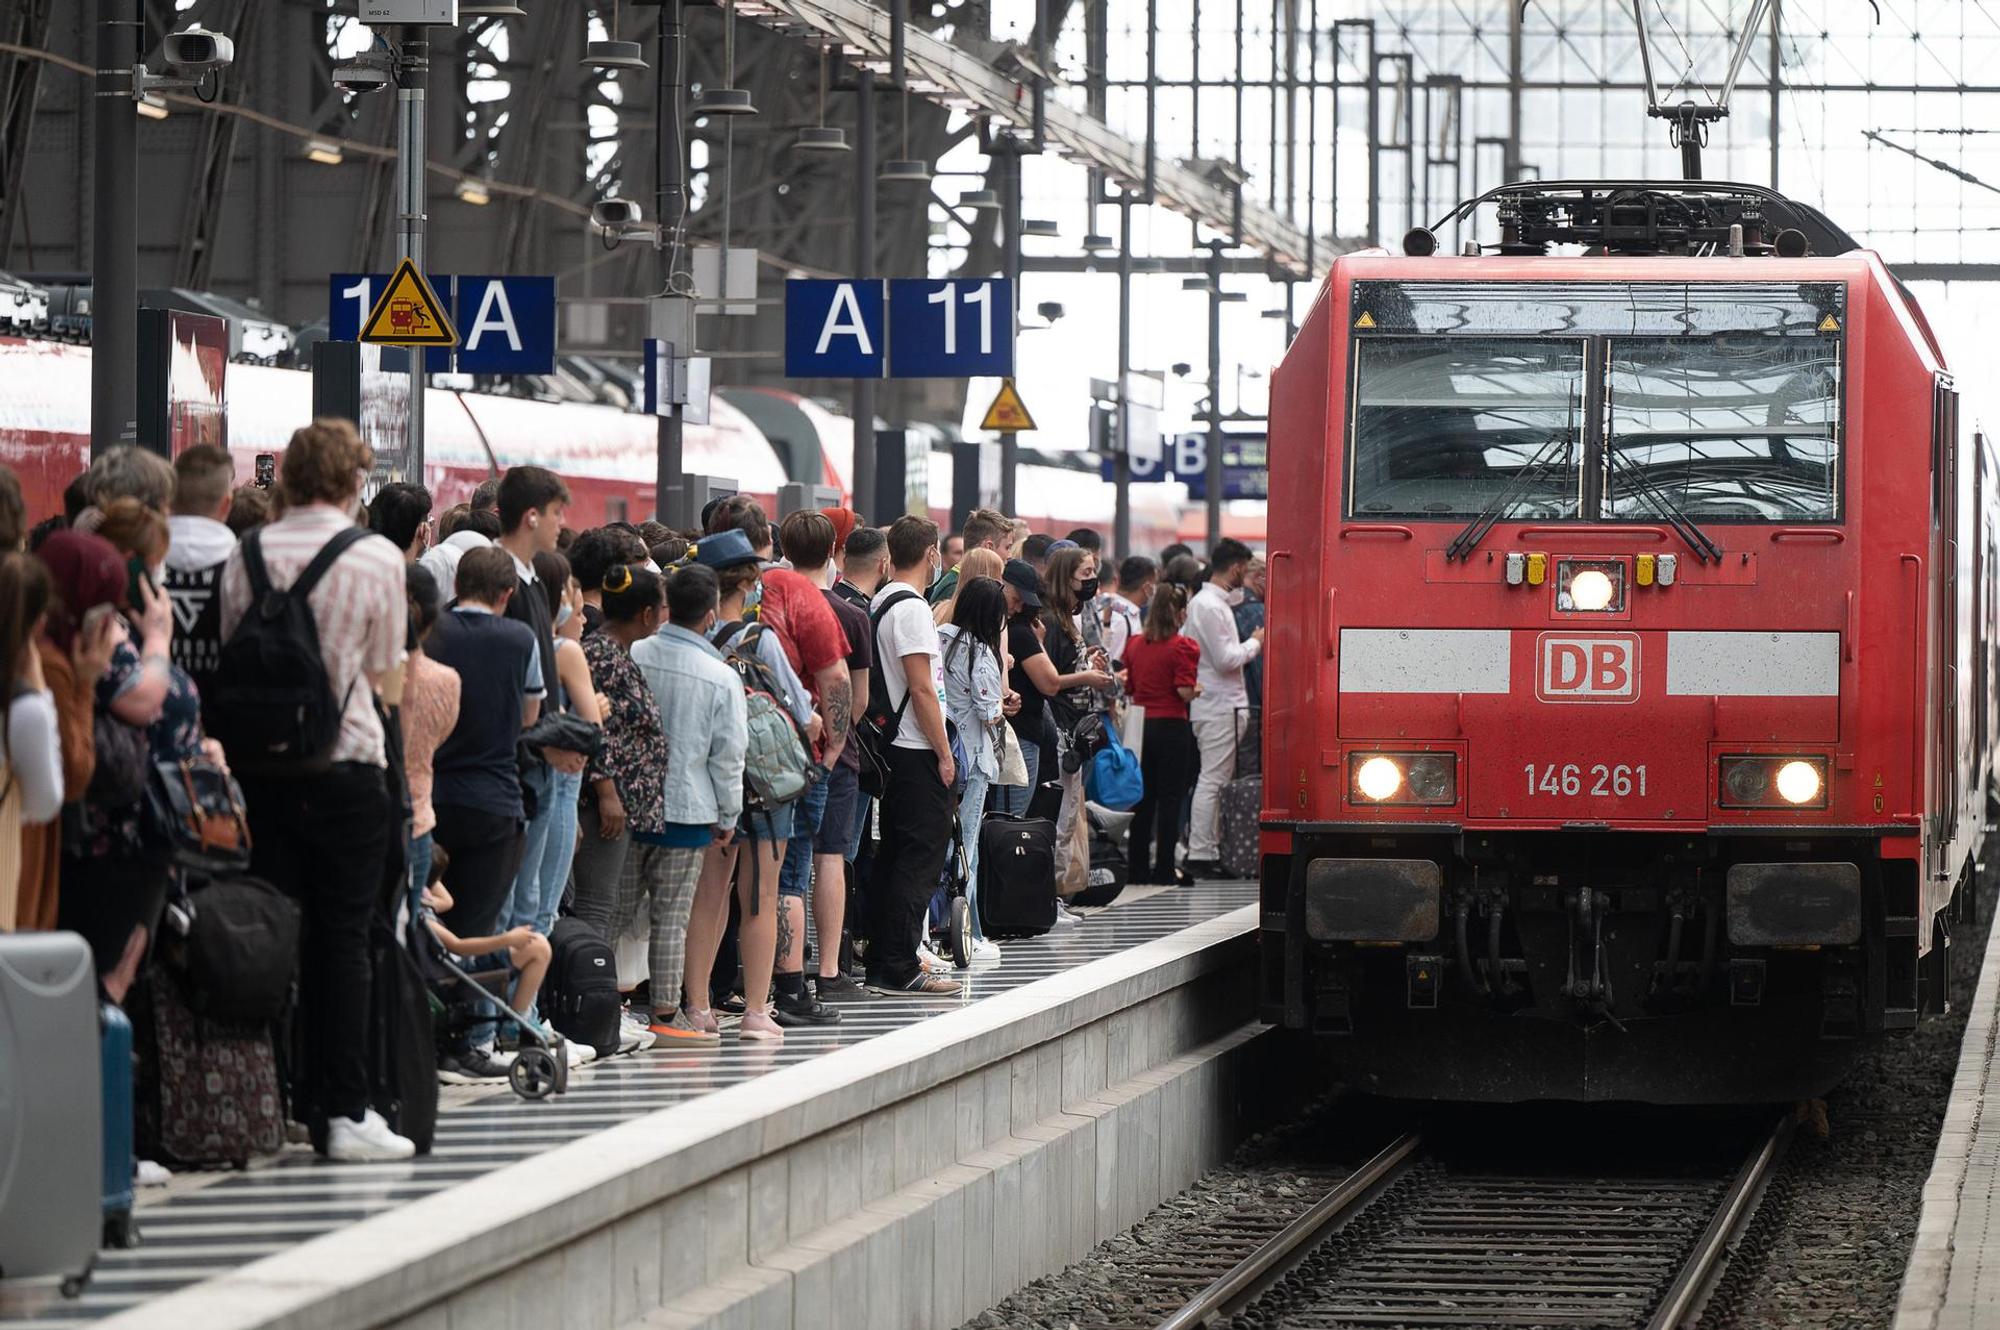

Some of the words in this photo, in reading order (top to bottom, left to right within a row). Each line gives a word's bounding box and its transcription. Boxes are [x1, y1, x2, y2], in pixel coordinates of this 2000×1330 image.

[465, 279, 523, 351] A
[814, 283, 874, 354] A
[927, 281, 992, 354] 11
[1174, 432, 1208, 475] B
[1550, 643, 1627, 691] DB
[1524, 763, 1581, 796] 146
[1590, 764, 1647, 797] 261
